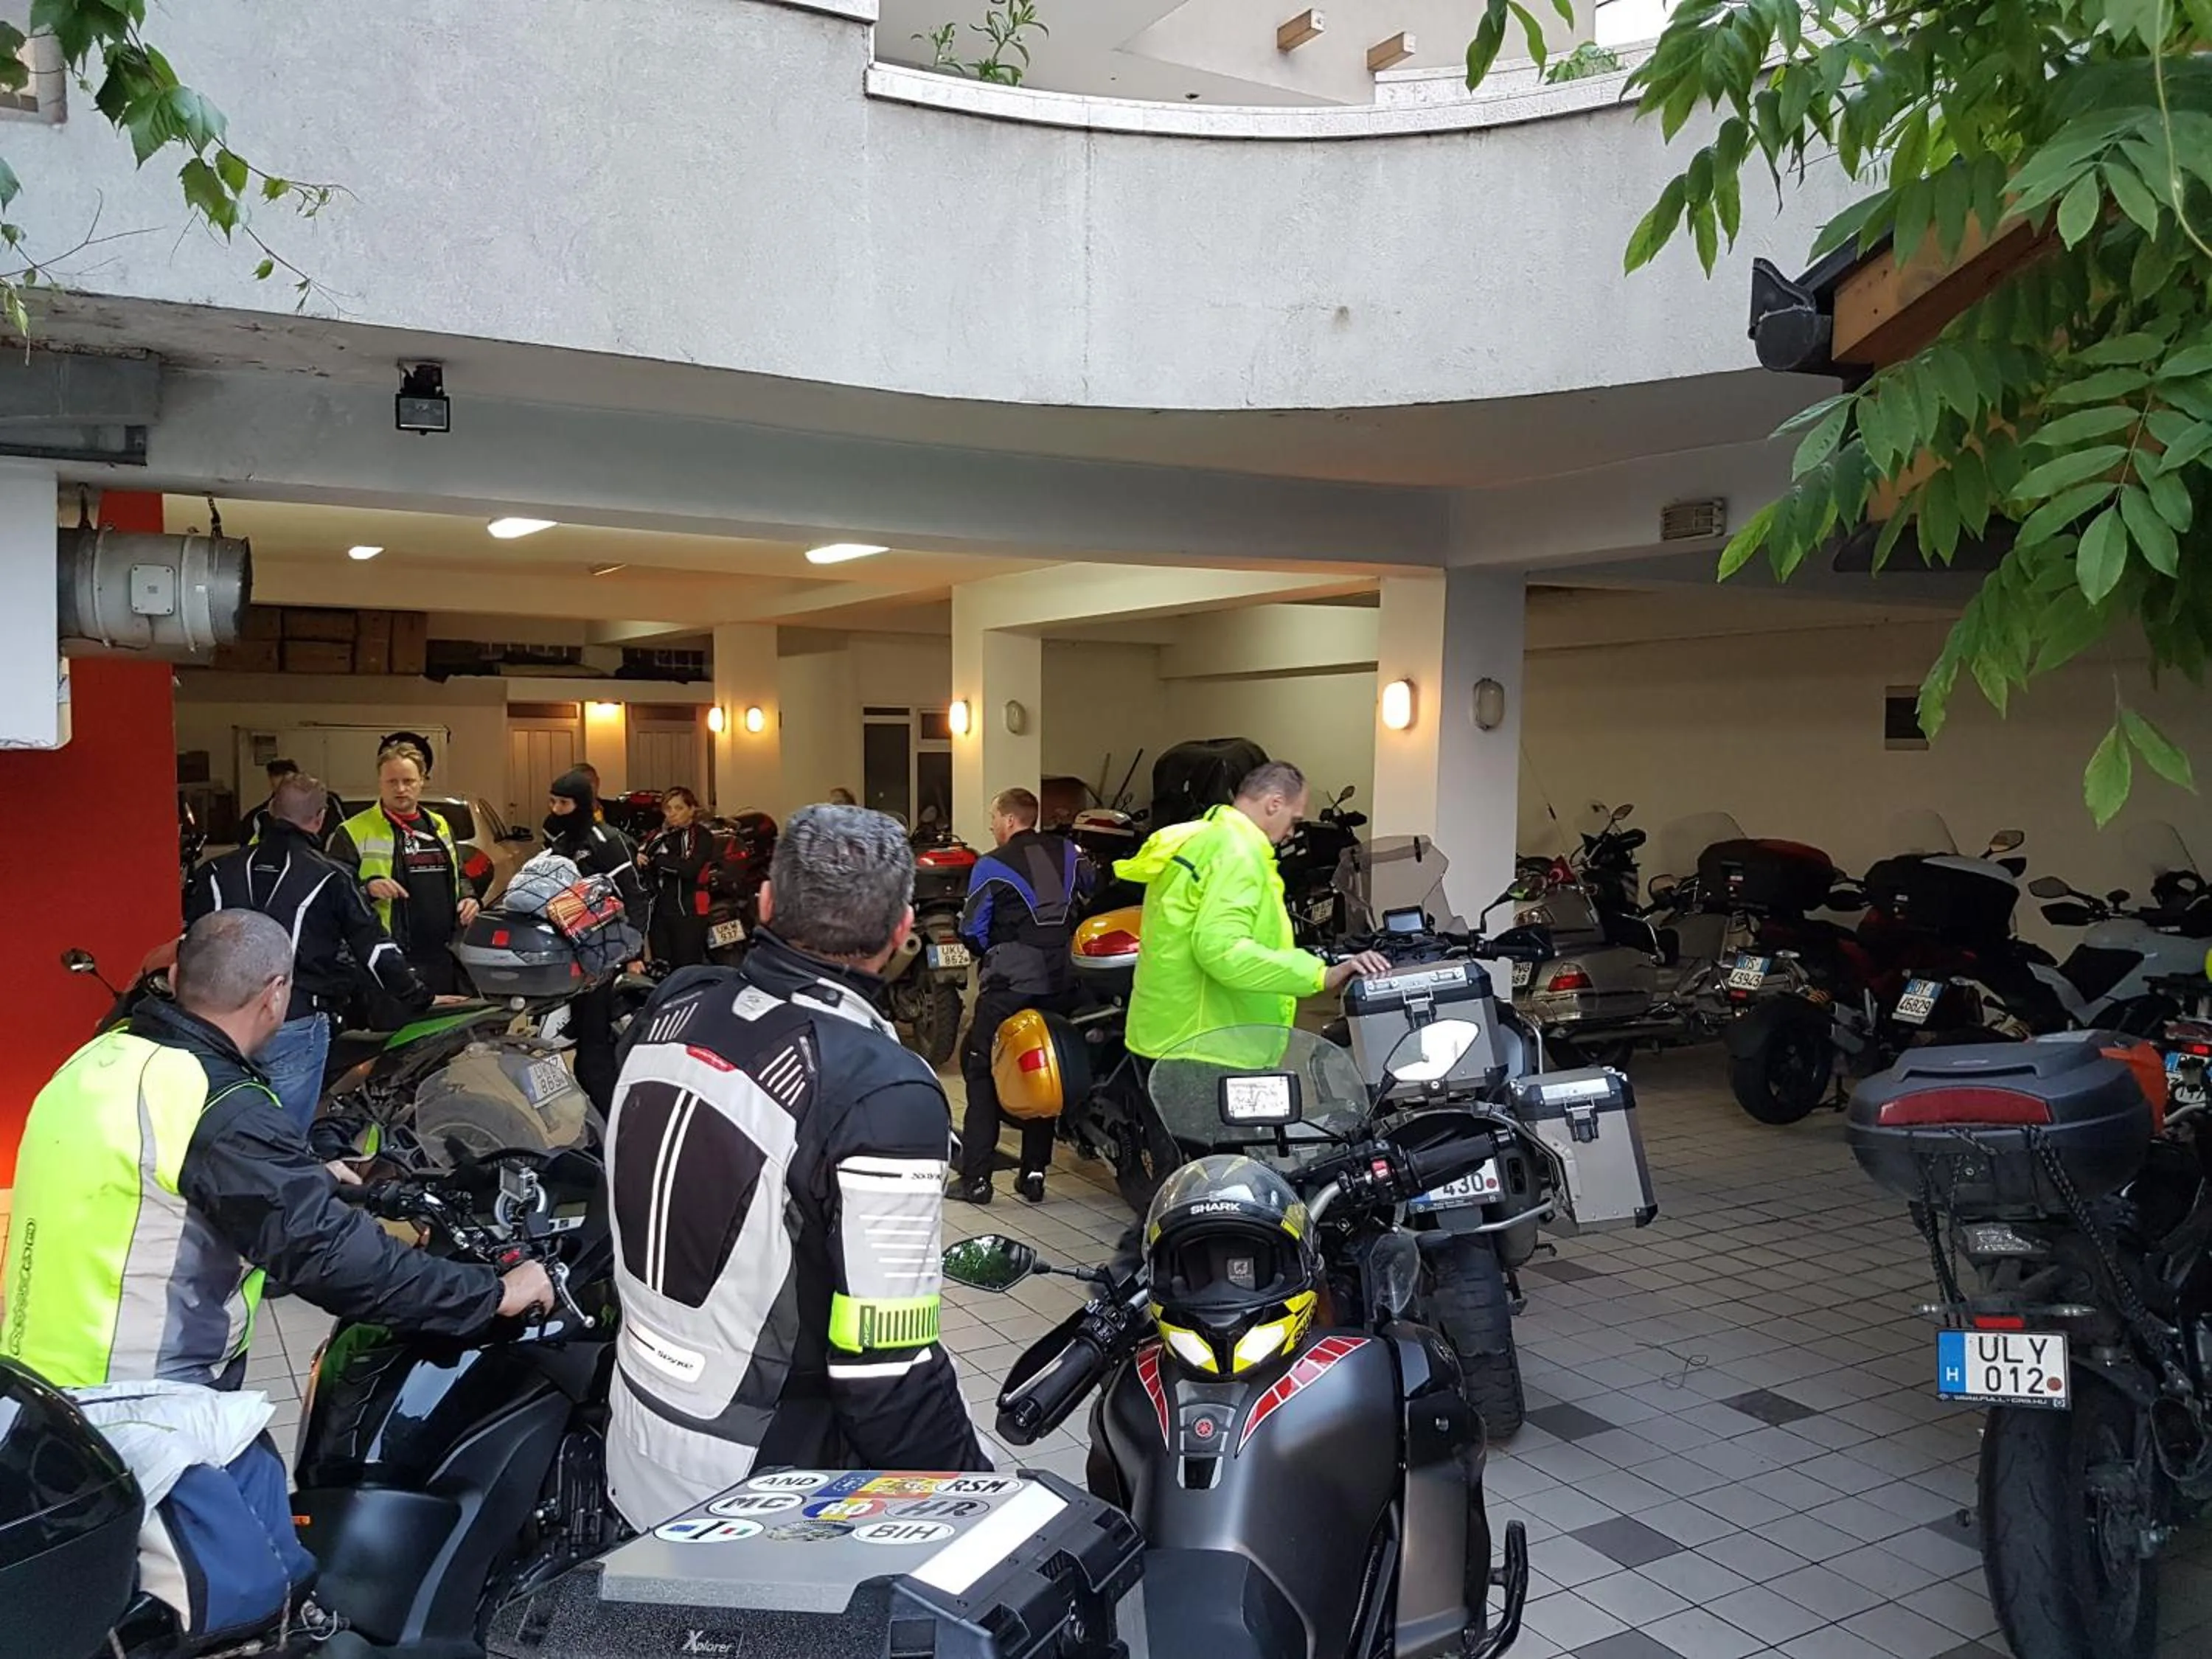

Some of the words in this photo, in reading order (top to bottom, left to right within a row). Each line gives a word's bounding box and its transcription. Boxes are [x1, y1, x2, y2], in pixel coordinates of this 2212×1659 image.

[1443, 1172, 1484, 1195] 430
[1190, 1203, 1241, 1215] SHARK
[1978, 1335, 2048, 1365] ULY
[1946, 1366, 1959, 1382] H
[1985, 1365, 2045, 1394] 012
[757, 1477, 818, 1486] AND
[945, 1478, 1010, 1493] RSM
[719, 1497, 793, 1509] MC
[817, 1499, 873, 1516] RO
[894, 1500, 979, 1517] HR
[866, 1525, 940, 1539] BIH
[682, 1630, 734, 1654] Xplorer
